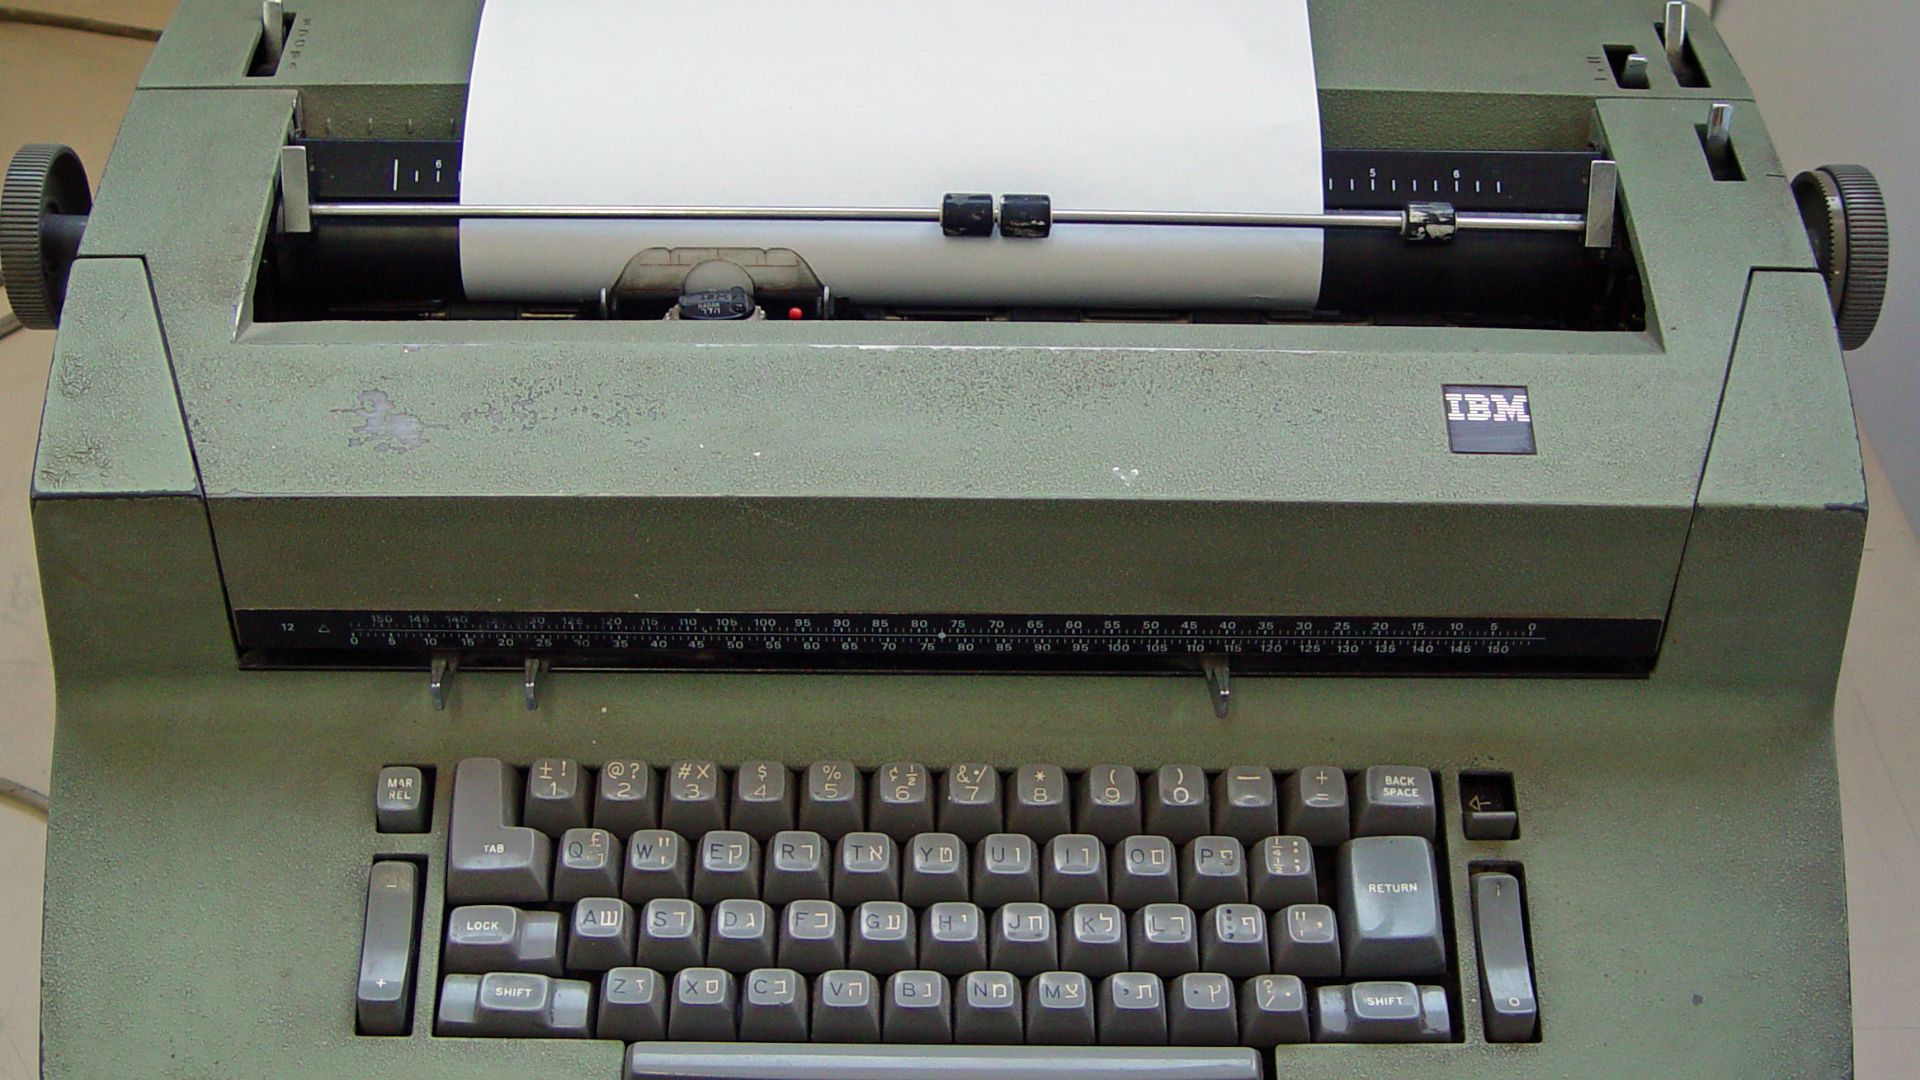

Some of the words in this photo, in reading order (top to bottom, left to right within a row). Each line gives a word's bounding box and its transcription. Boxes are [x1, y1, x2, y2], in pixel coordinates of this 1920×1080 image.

[436, 159, 442, 169] 6
[1369, 168, 1376, 177] 5
[1453, 169, 1460, 179] 6
[1445, 394, 1530, 422] IBM
[281, 623, 295, 632] 12
[680, 618, 697, 626] 110
[716, 618, 738, 626] 105
[754, 618, 776, 626] 100
[794, 618, 810, 626] 95
[834, 619, 850, 627] 90
[872, 619, 888, 627] 85
[911, 619, 928, 627] 80
[951, 619, 966, 627] 75
[989, 620, 1004, 628] 70
[1027, 620, 1044, 628] 65
[1066, 620, 1082, 628] 60
[1104, 620, 1120, 628] 55
[1143, 621, 1159, 629] 50
[1181, 621, 1198, 629] 45
[1219, 621, 1236, 629] 40
[1258, 621, 1274, 629] 35
[1296, 621, 1312, 629] 30
[1334, 622, 1350, 630] 25
[1372, 622, 1388, 630] 20
[1412, 622, 1424, 630] 15
[1450, 622, 1464, 630] 10
[1490, 623, 1498, 631] 5
[1528, 623, 1536, 631] 0
[351, 637, 358, 646] 0
[388, 638, 396, 646] 5
[424, 638, 438, 646] 10
[461, 638, 474, 646] 15
[498, 638, 514, 647] 20
[536, 639, 552, 647] 25
[613, 640, 628, 648] 35
[650, 640, 667, 648] 40
[688, 640, 704, 648] 45
[727, 641, 744, 649] 50
[766, 641, 782, 649] 55
[803, 641, 820, 649] 60
[842, 641, 858, 650] 65
[881, 642, 896, 650] 70
[920, 642, 934, 650] 75
[958, 642, 974, 650] 80
[996, 642, 1012, 651] 85
[1034, 642, 1050, 650] 90
[1072, 642, 1088, 651] 95
[1108, 643, 1130, 651] 100
[1146, 643, 1168, 651] 105
[1187, 643, 1204, 651] 110
[1225, 643, 1242, 652] 115
[1261, 644, 1282, 652] 120
[1299, 644, 1320, 652] 125
[1337, 644, 1358, 652] 130
[1374, 644, 1396, 653] 135
[1412, 645, 1434, 653] 140
[1450, 645, 1471, 653] 145
[1488, 645, 1509, 653] 150
[608, 762, 624, 780] @
[630, 763, 640, 779] ?
[678, 763, 692, 779] #
[757, 764, 767, 781] $
[823, 765, 842, 780] %
[956, 765, 970, 783] &
[387, 778, 412, 788] MAR
[1384, 776, 1415, 786] BACK
[388, 790, 411, 800] REL
[550, 782, 557, 796] 1
[616, 783, 631, 798] 2
[686, 784, 700, 799] 3
[753, 784, 768, 798] 4
[824, 784, 838, 798] 5
[896, 786, 910, 800] 6
[964, 785, 979, 800] 7
[1033, 788, 1048, 802] 8
[1105, 788, 1120, 803] 9
[1383, 787, 1419, 798] SPACE
[483, 844, 504, 854] TAB
[568, 842, 583, 859] Q
[636, 843, 653, 859] W
[710, 844, 724, 860] E
[782, 844, 794, 860] R
[850, 845, 864, 861] T
[920, 847, 933, 862] Y
[992, 846, 1005, 862] U
[1130, 848, 1145, 864] O
[1201, 850, 1214, 864] P
[1368, 882, 1418, 894] RETURN
[466, 920, 500, 931] LOCK
[582, 910, 597, 926] A
[653, 911, 667, 928] S
[723, 911, 738, 927] D
[794, 912, 808, 927] F
[866, 913, 880, 930] G
[938, 915, 951, 930] H
[1008, 914, 1020, 930] J
[1082, 916, 1095, 933] K
[1152, 915, 1164, 932] L
[495, 987, 533, 997] SHIFT
[613, 979, 626, 994] Z
[685, 980, 698, 994] X
[754, 979, 768, 994] C
[830, 982, 844, 996] V
[903, 982, 916, 998] B
[974, 982, 988, 997] N
[1045, 984, 1061, 1000] M
[1366, 996, 1404, 1006] SHIFT
